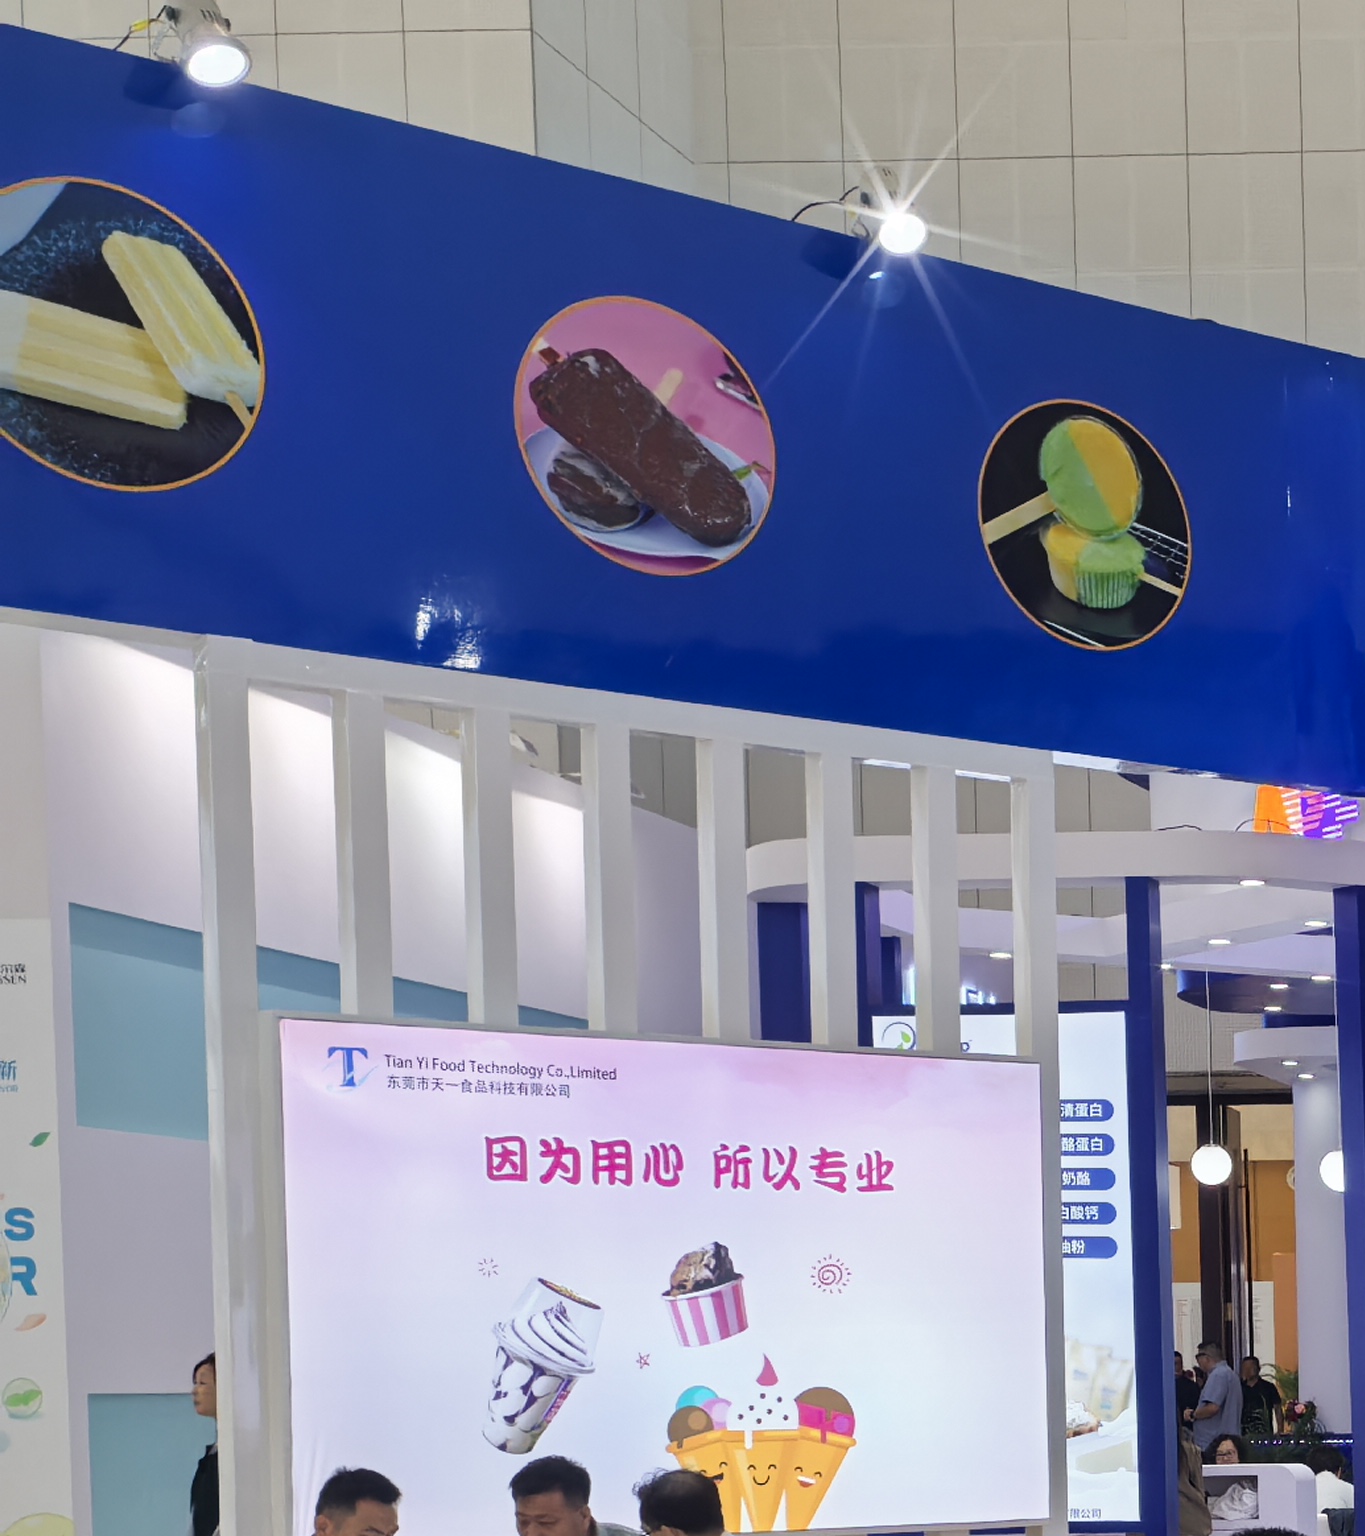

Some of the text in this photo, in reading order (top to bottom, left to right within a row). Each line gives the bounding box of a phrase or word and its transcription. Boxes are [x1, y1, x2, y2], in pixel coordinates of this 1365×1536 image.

[384, 1054, 413, 1069] Tian
[416, 1056, 429, 1070] Yi
[432, 1058, 466, 1073] Food
[469, 1060, 544, 1080] Technology
[386, 1075, 572, 1099] 东莞市天一食品科技有限公司
[484, 1134, 895, 1194] 因为用心 所以专业
[1062, 1171, 1091, 1186] 奶酪
